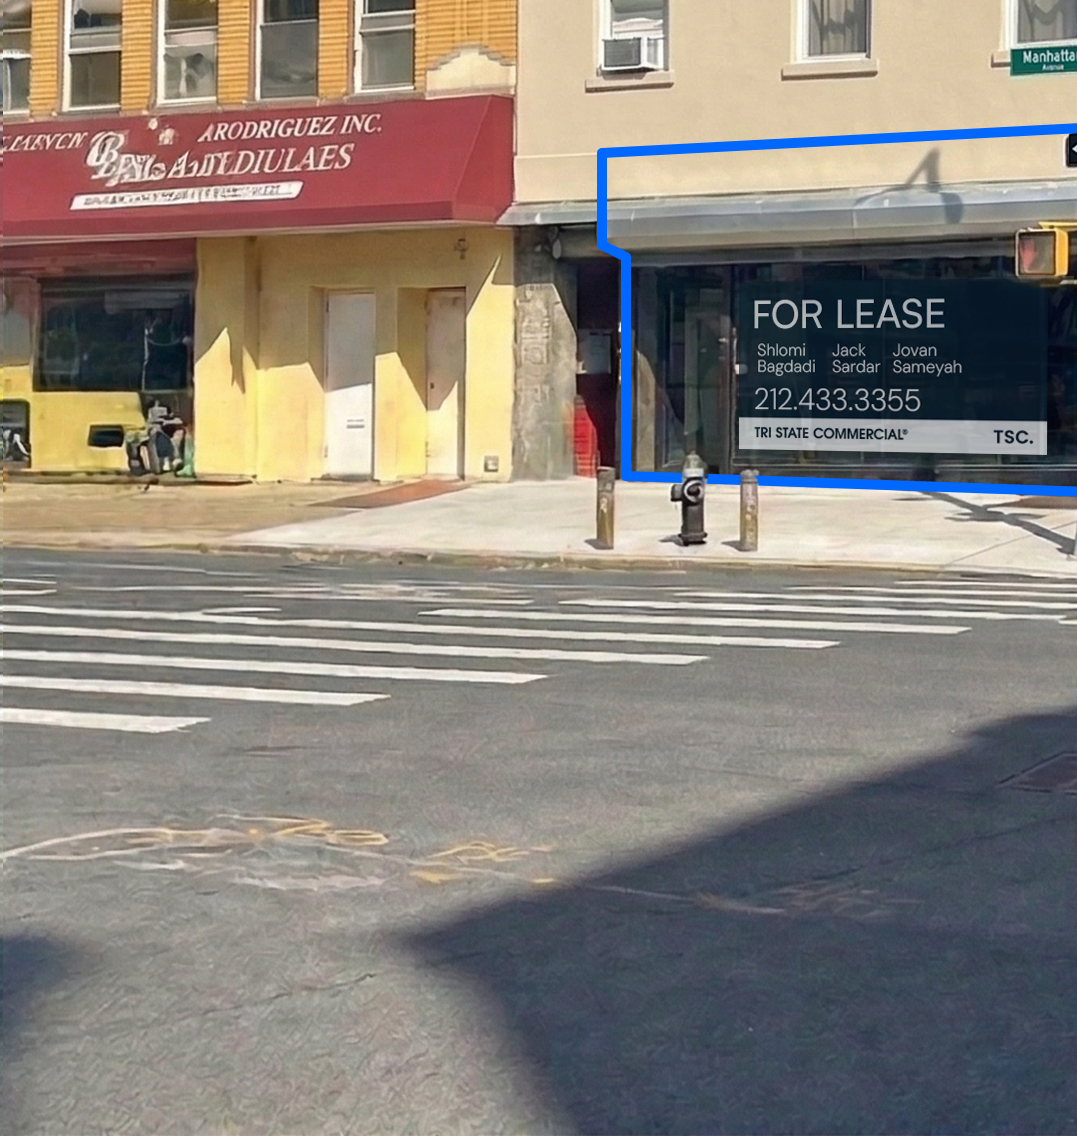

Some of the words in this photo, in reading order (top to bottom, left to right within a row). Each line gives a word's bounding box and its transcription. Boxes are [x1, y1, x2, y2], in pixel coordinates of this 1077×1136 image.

[340, 114, 382, 135] INC.
[753, 299, 823, 330] FOR
[836, 298, 946, 330] LEASE
[757, 342, 806, 357] Shlomi
[832, 343, 867, 357] Jack
[892, 343, 938, 357] Jovan
[757, 359, 816, 377] Bagdadi
[831, 359, 881, 374] Sardar
[892, 359, 963, 378] Sameyah
[753, 387, 922, 412] 212.433.3355
[754, 426, 772, 439] TRI
[775, 427, 810, 440] STATE
[993, 429, 1035, 445] TSC.
